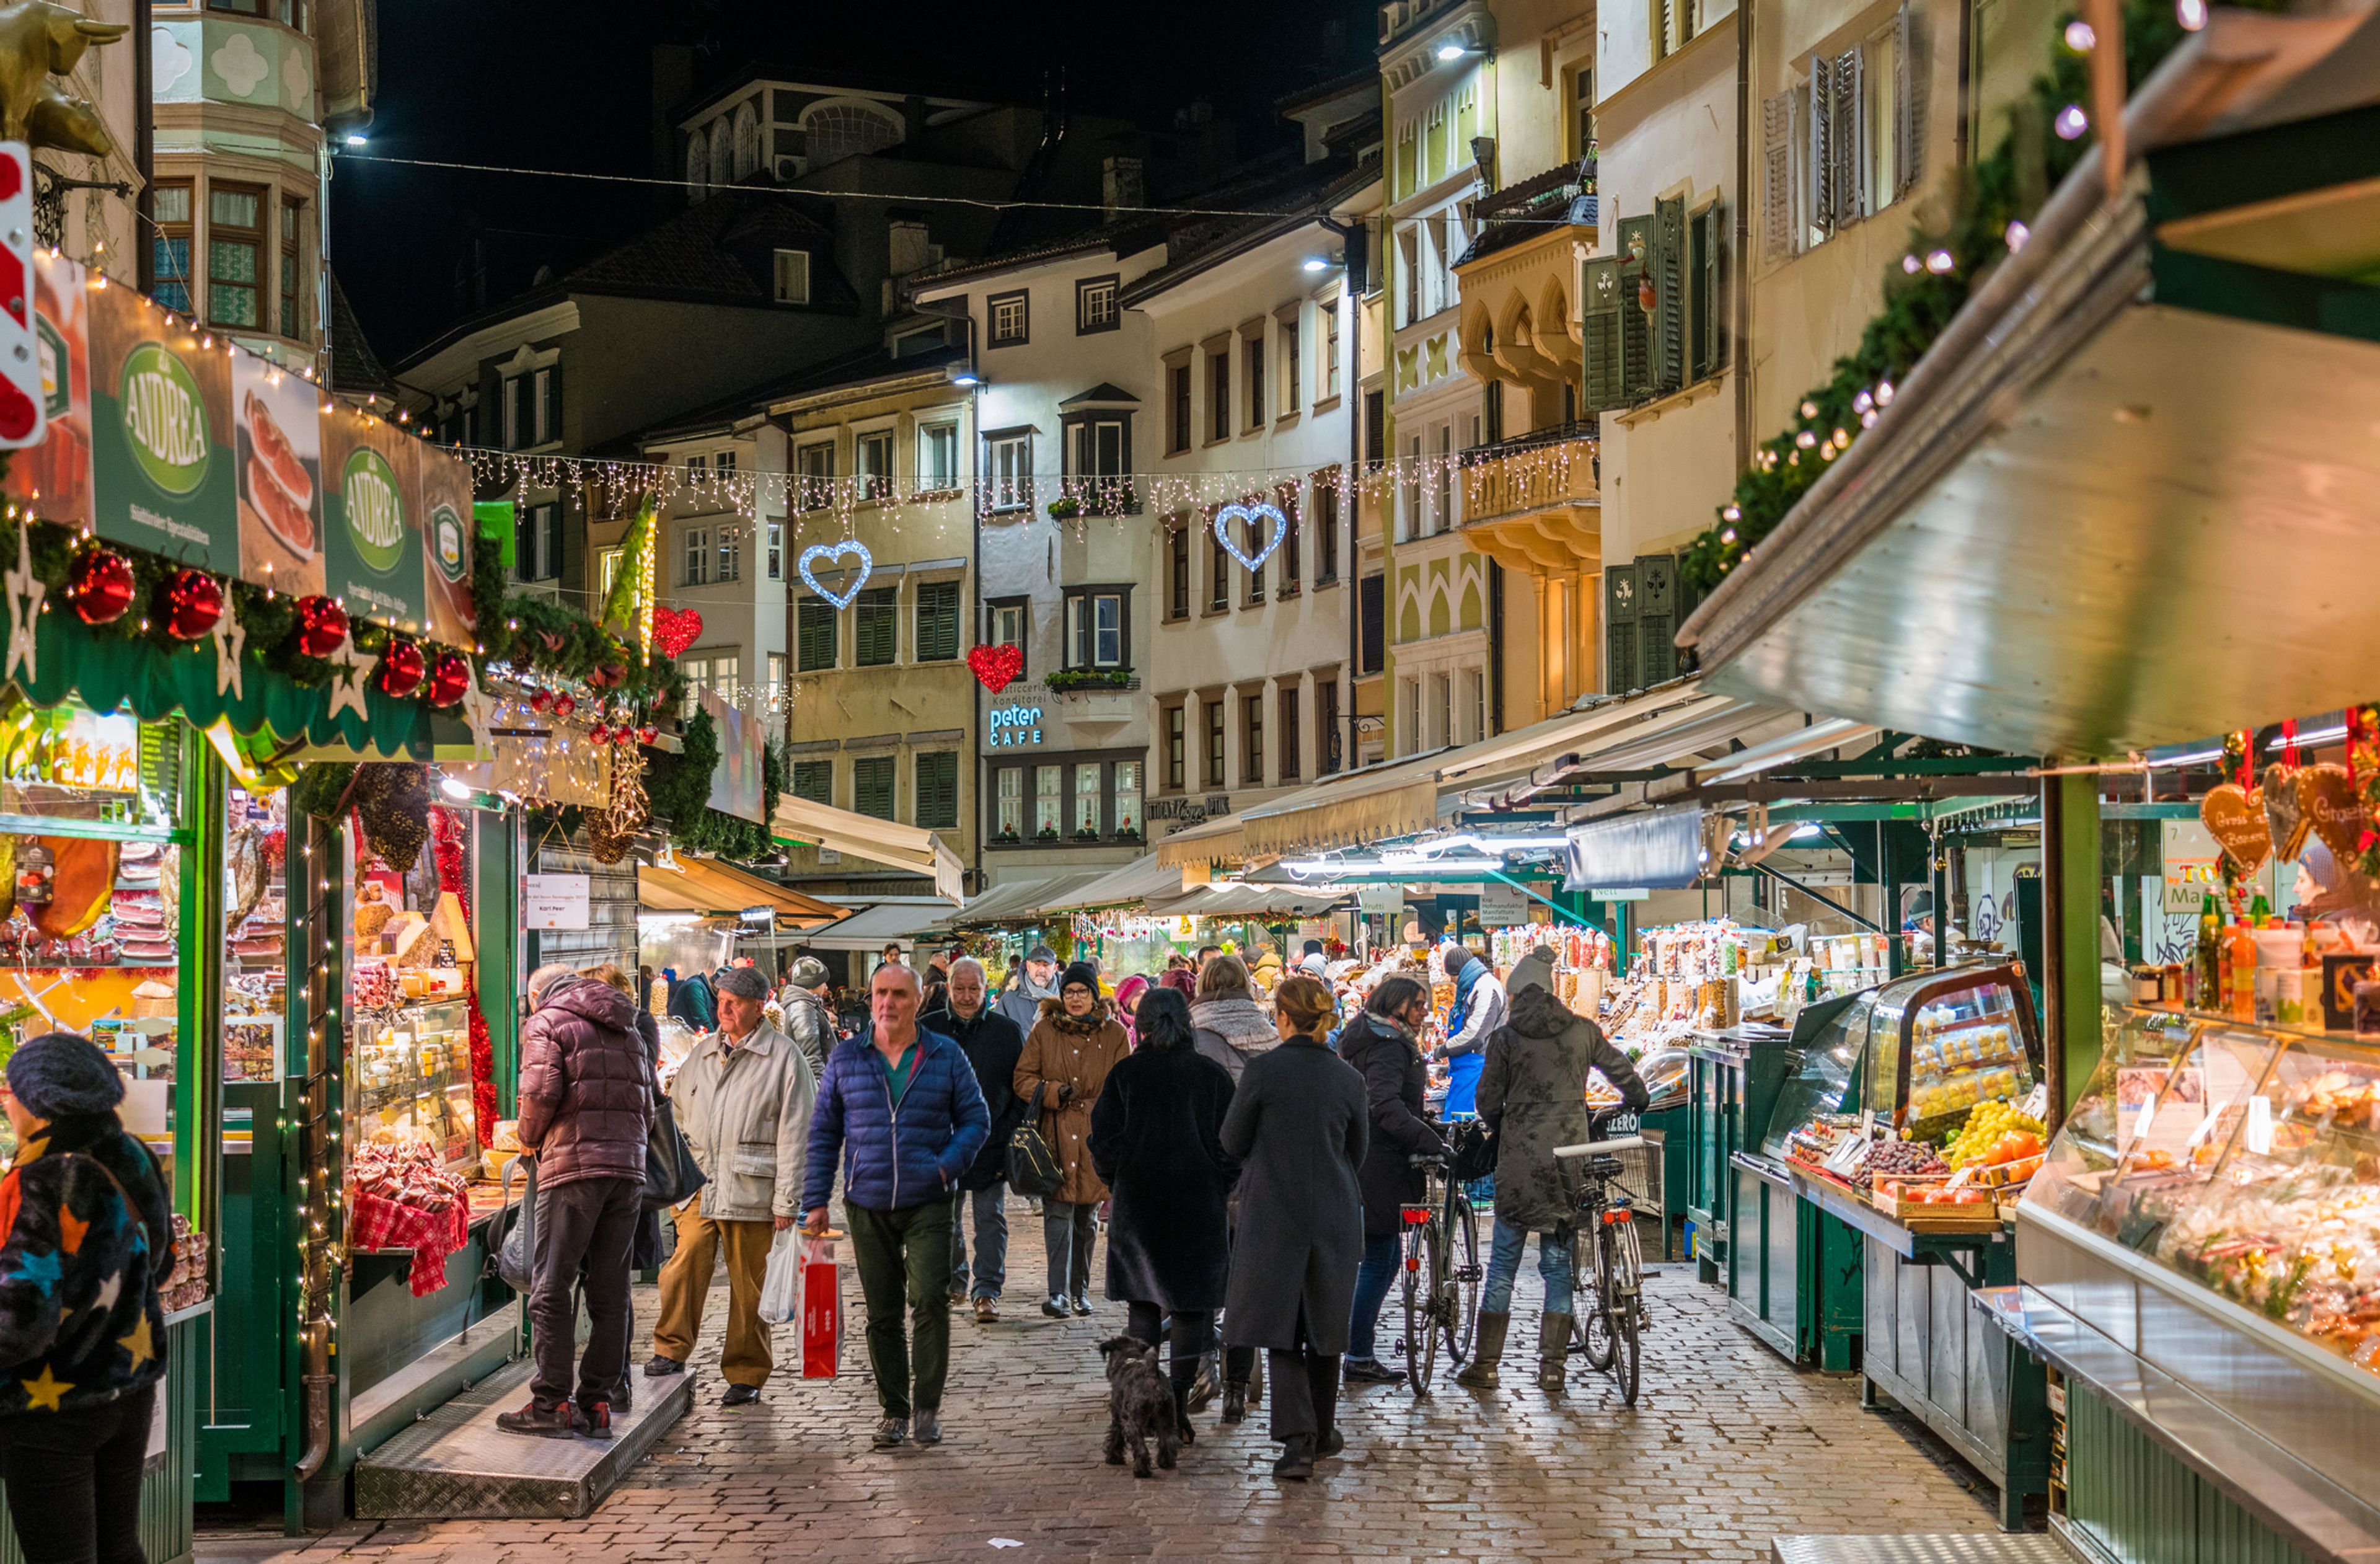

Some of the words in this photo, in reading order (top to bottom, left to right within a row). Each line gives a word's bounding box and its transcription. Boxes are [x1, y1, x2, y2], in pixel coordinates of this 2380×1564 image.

[125, 372, 207, 466] ANDREA
[346, 472, 403, 548] ANDREA
[993, 694, 1046, 705] Konditorei
[990, 704, 1042, 733] peter
[990, 730, 1042, 746] CAFE
[2171, 828, 2178, 840] 7
[2167, 875, 2180, 885] by
[1610, 1113, 1637, 1131] ZERO
